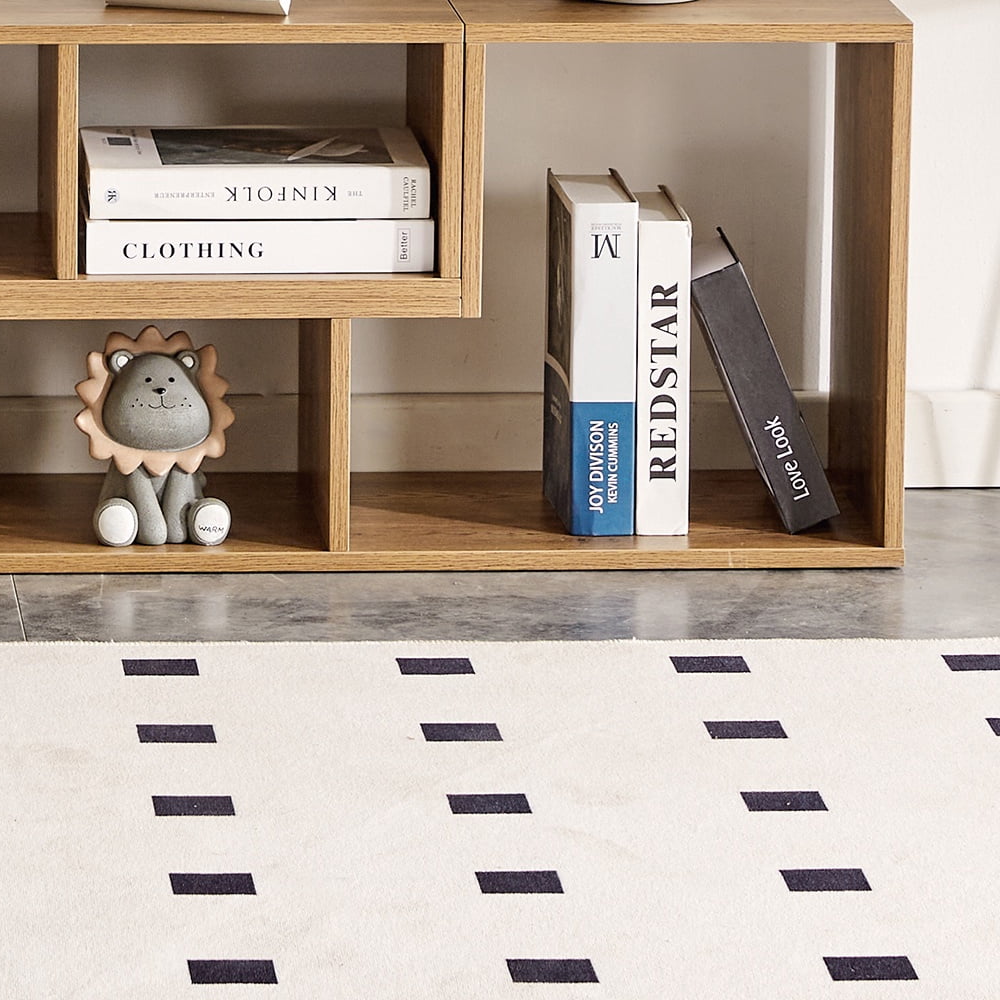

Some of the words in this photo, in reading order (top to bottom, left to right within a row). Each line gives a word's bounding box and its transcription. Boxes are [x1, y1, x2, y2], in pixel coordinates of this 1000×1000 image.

[224, 185, 337, 203] KINFOLK
[123, 241, 264, 259] CLOTHING
[399, 231, 408, 260] Better
[590, 233, 622, 260] M
[649, 281, 679, 483] REDSTAR
[588, 420, 605, 482] DIVISON
[607, 422, 619, 473] CUMMINS
[763, 415, 794, 459] Look
[607, 473, 618, 504] KEVIN
[784, 459, 810, 501] Love
[588, 485, 604, 514] JOY
[198, 524, 225, 533] WARM
